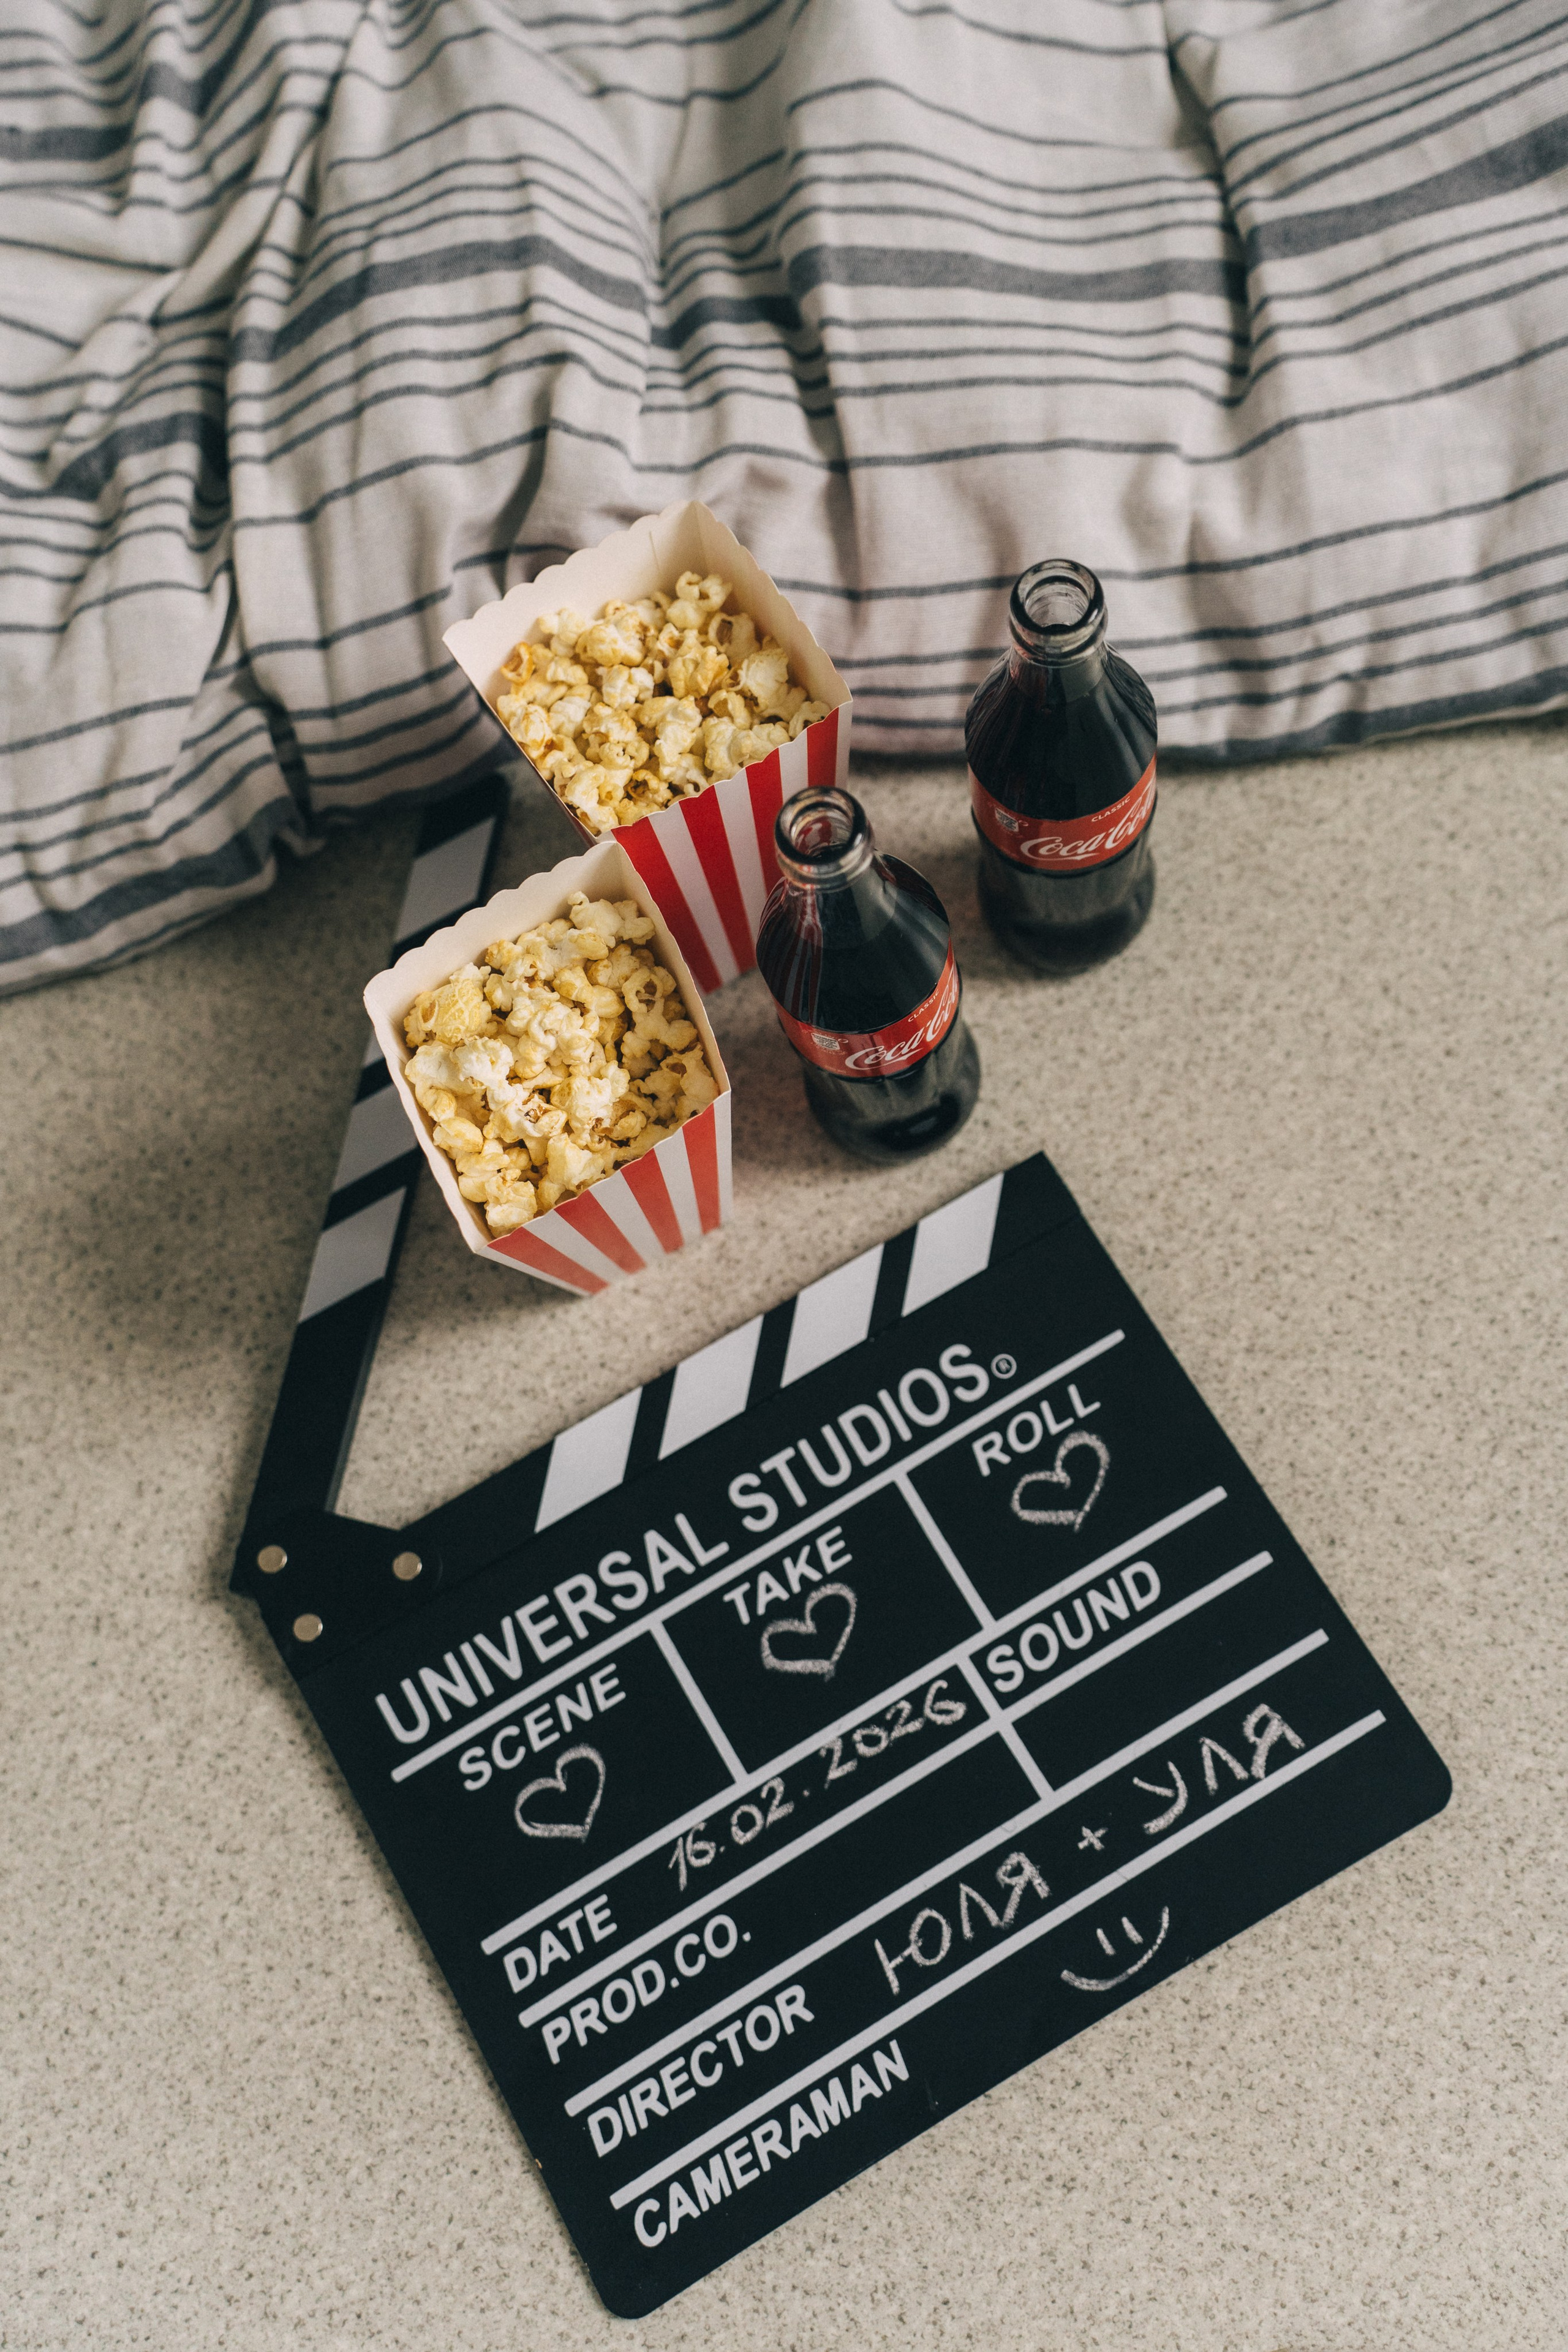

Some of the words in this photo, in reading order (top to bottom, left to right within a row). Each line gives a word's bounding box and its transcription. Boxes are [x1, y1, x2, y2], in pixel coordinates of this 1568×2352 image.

[1091, 796, 1131, 823] CLASSIC
[908, 988, 940, 1023] CLASSIC
[972, 1384, 1101, 1477] ROLL
[375, 1513, 729, 1744] UNIVERSAL
[723, 1526, 853, 1626] TAKE
[986, 1561, 1161, 1694] SOUND
[459, 1663, 626, 1792] SCENE
[873, 1852, 1052, 1995] ЮЛЯ
[1077, 1825, 1109, 1851] +
[1133, 1703, 1306, 1835] УЛЯ
[503, 1894, 617, 1994] DATE
[541, 1914, 753, 2065] PROD.CO.
[587, 1985, 815, 2158] DIRECTOR
[634, 2039, 910, 2248] CAMERAMAN
